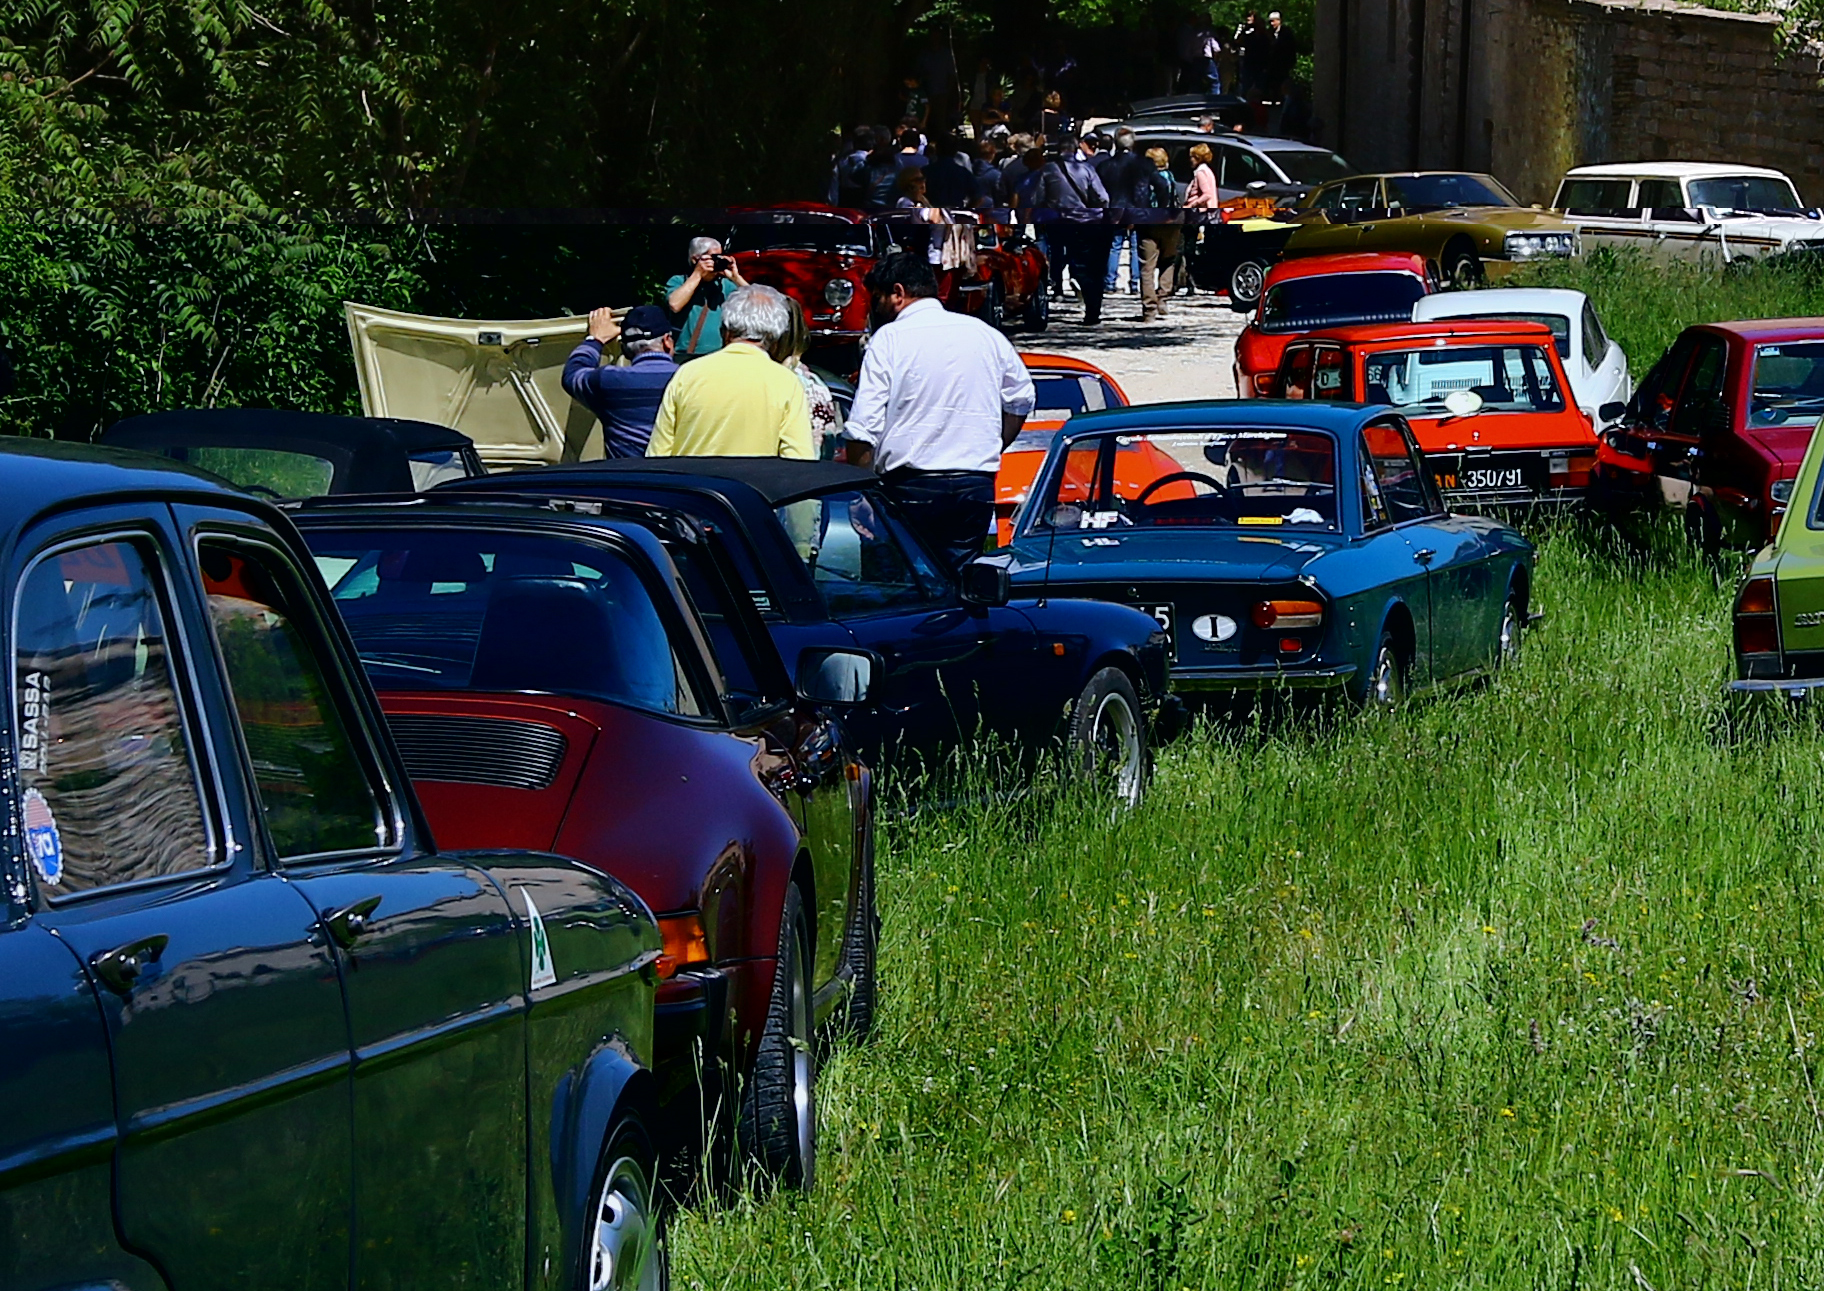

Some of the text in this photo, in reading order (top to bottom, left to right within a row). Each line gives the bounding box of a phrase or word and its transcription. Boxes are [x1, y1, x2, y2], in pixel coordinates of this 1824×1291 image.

[1467, 469, 1521, 488] 350791
[1079, 511, 1119, 529] HF
[1209, 616, 1220, 639] I
[22, 672, 42, 749] SASSA
